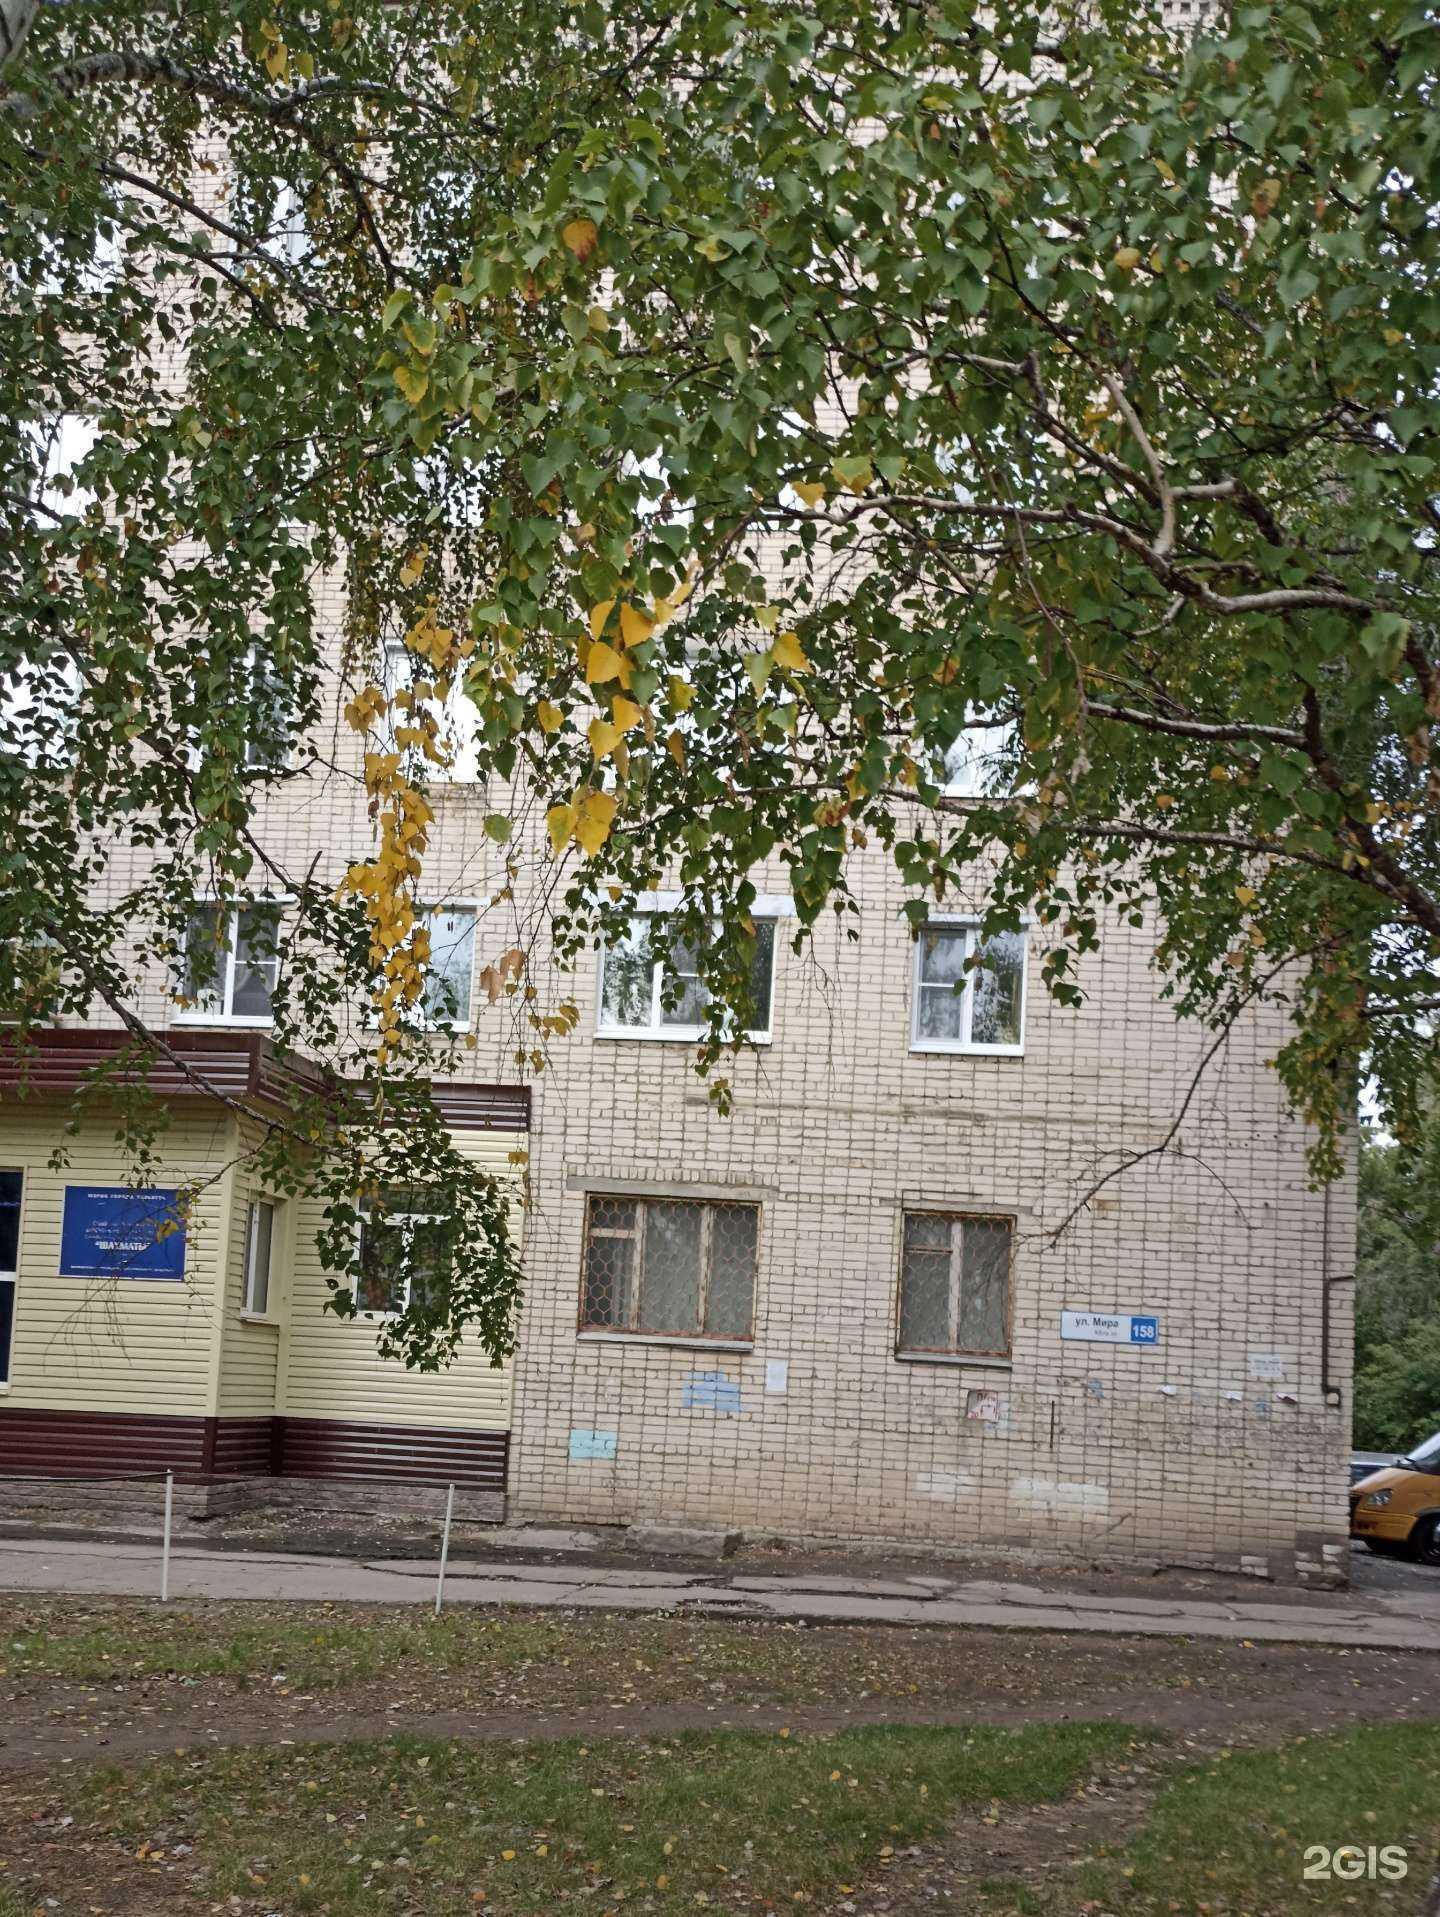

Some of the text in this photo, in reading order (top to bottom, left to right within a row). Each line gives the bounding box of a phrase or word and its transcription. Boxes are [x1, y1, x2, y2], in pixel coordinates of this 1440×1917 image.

[1075, 1317, 1119, 1329] ул. Мира
[1133, 1325, 1154, 1338] 158
